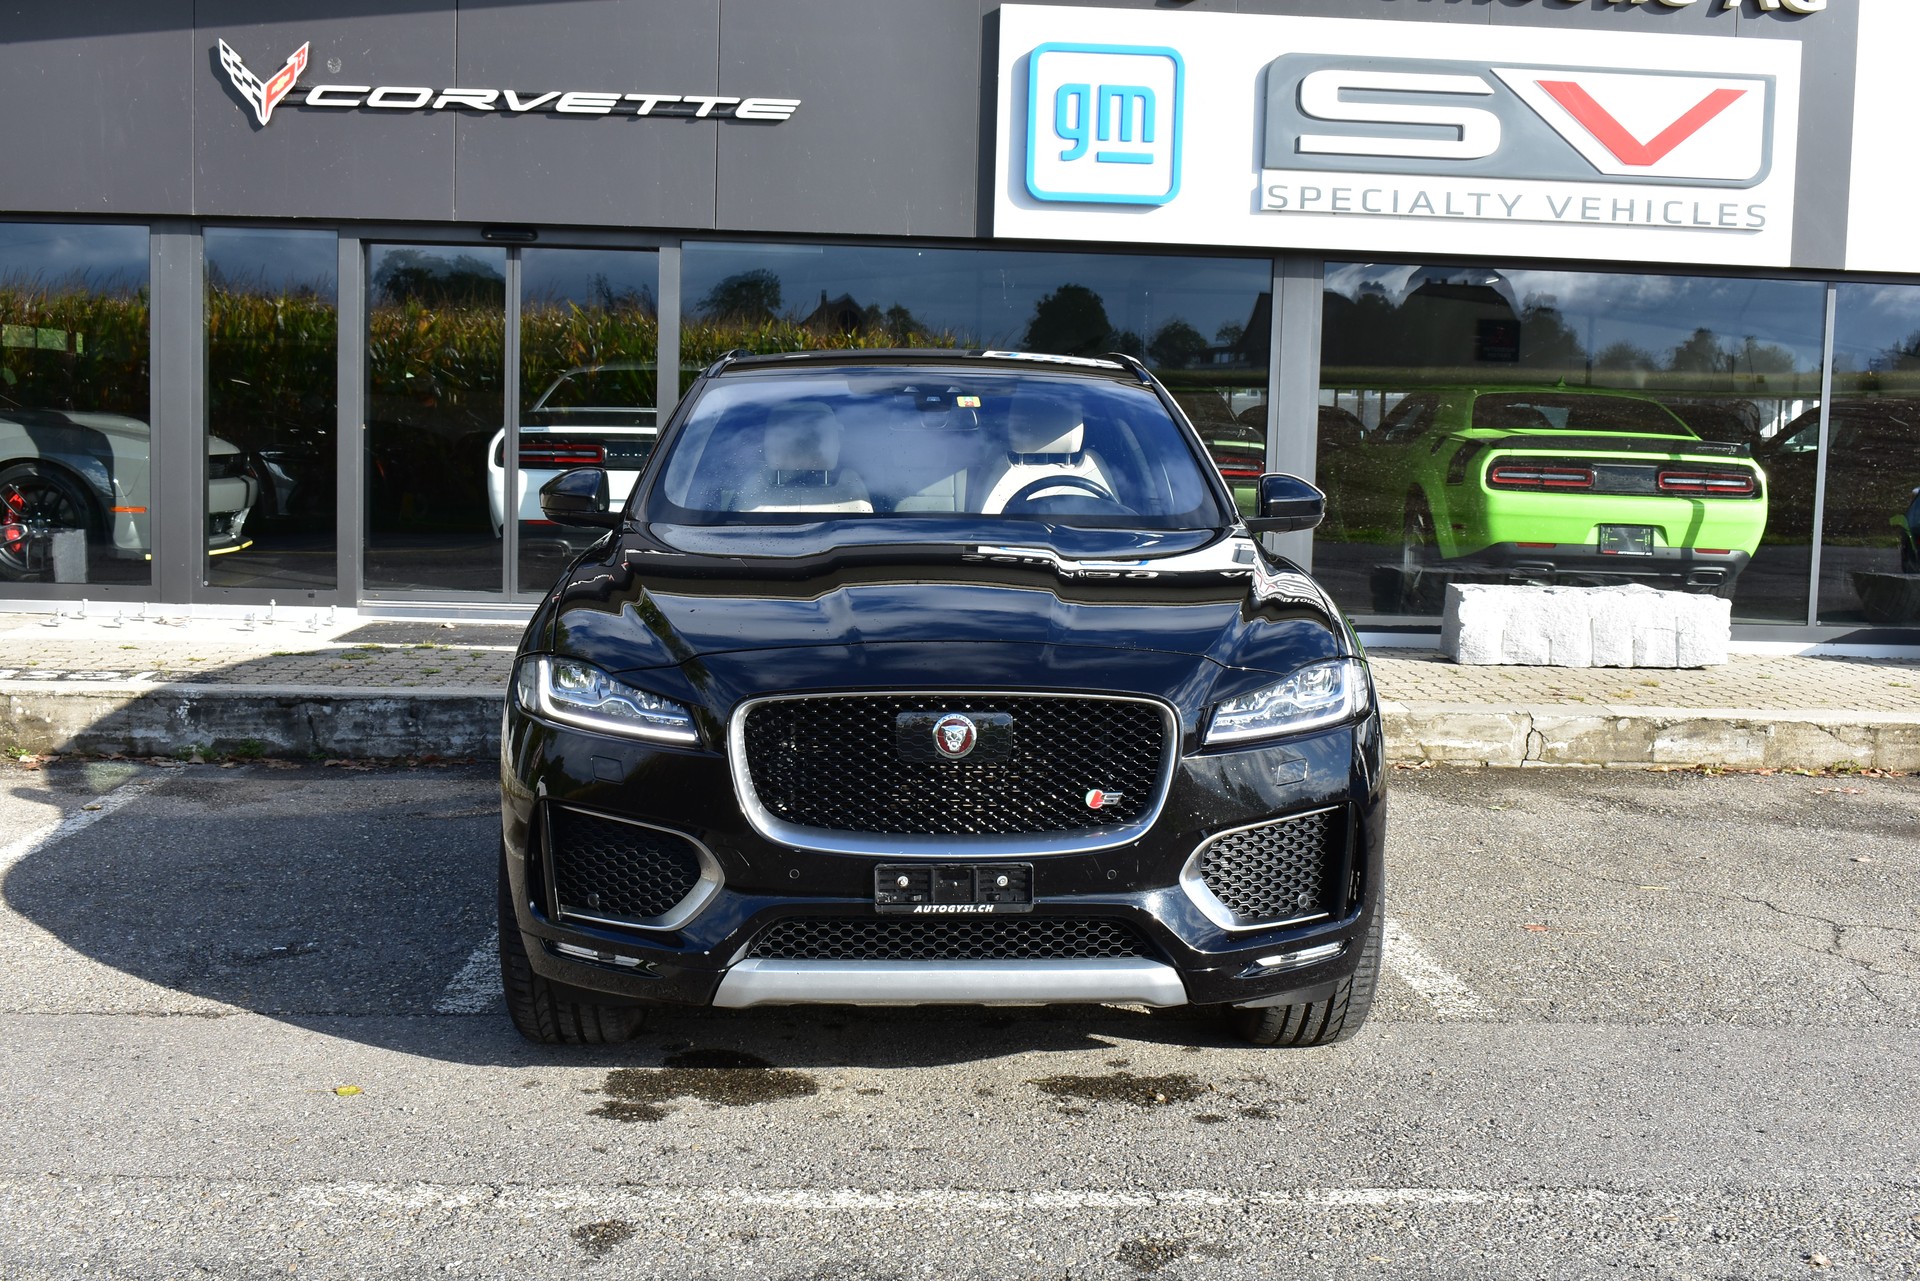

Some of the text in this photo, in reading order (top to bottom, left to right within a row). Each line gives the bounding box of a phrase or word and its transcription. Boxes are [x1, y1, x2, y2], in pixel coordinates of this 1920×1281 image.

[304, 84, 802, 120] CORVETTE
[1055, 83, 1156, 163] gm
[1267, 184, 1767, 228] SPECIALTY VEHICLES
[913, 904, 995, 914] AUTOGYSI.CH
